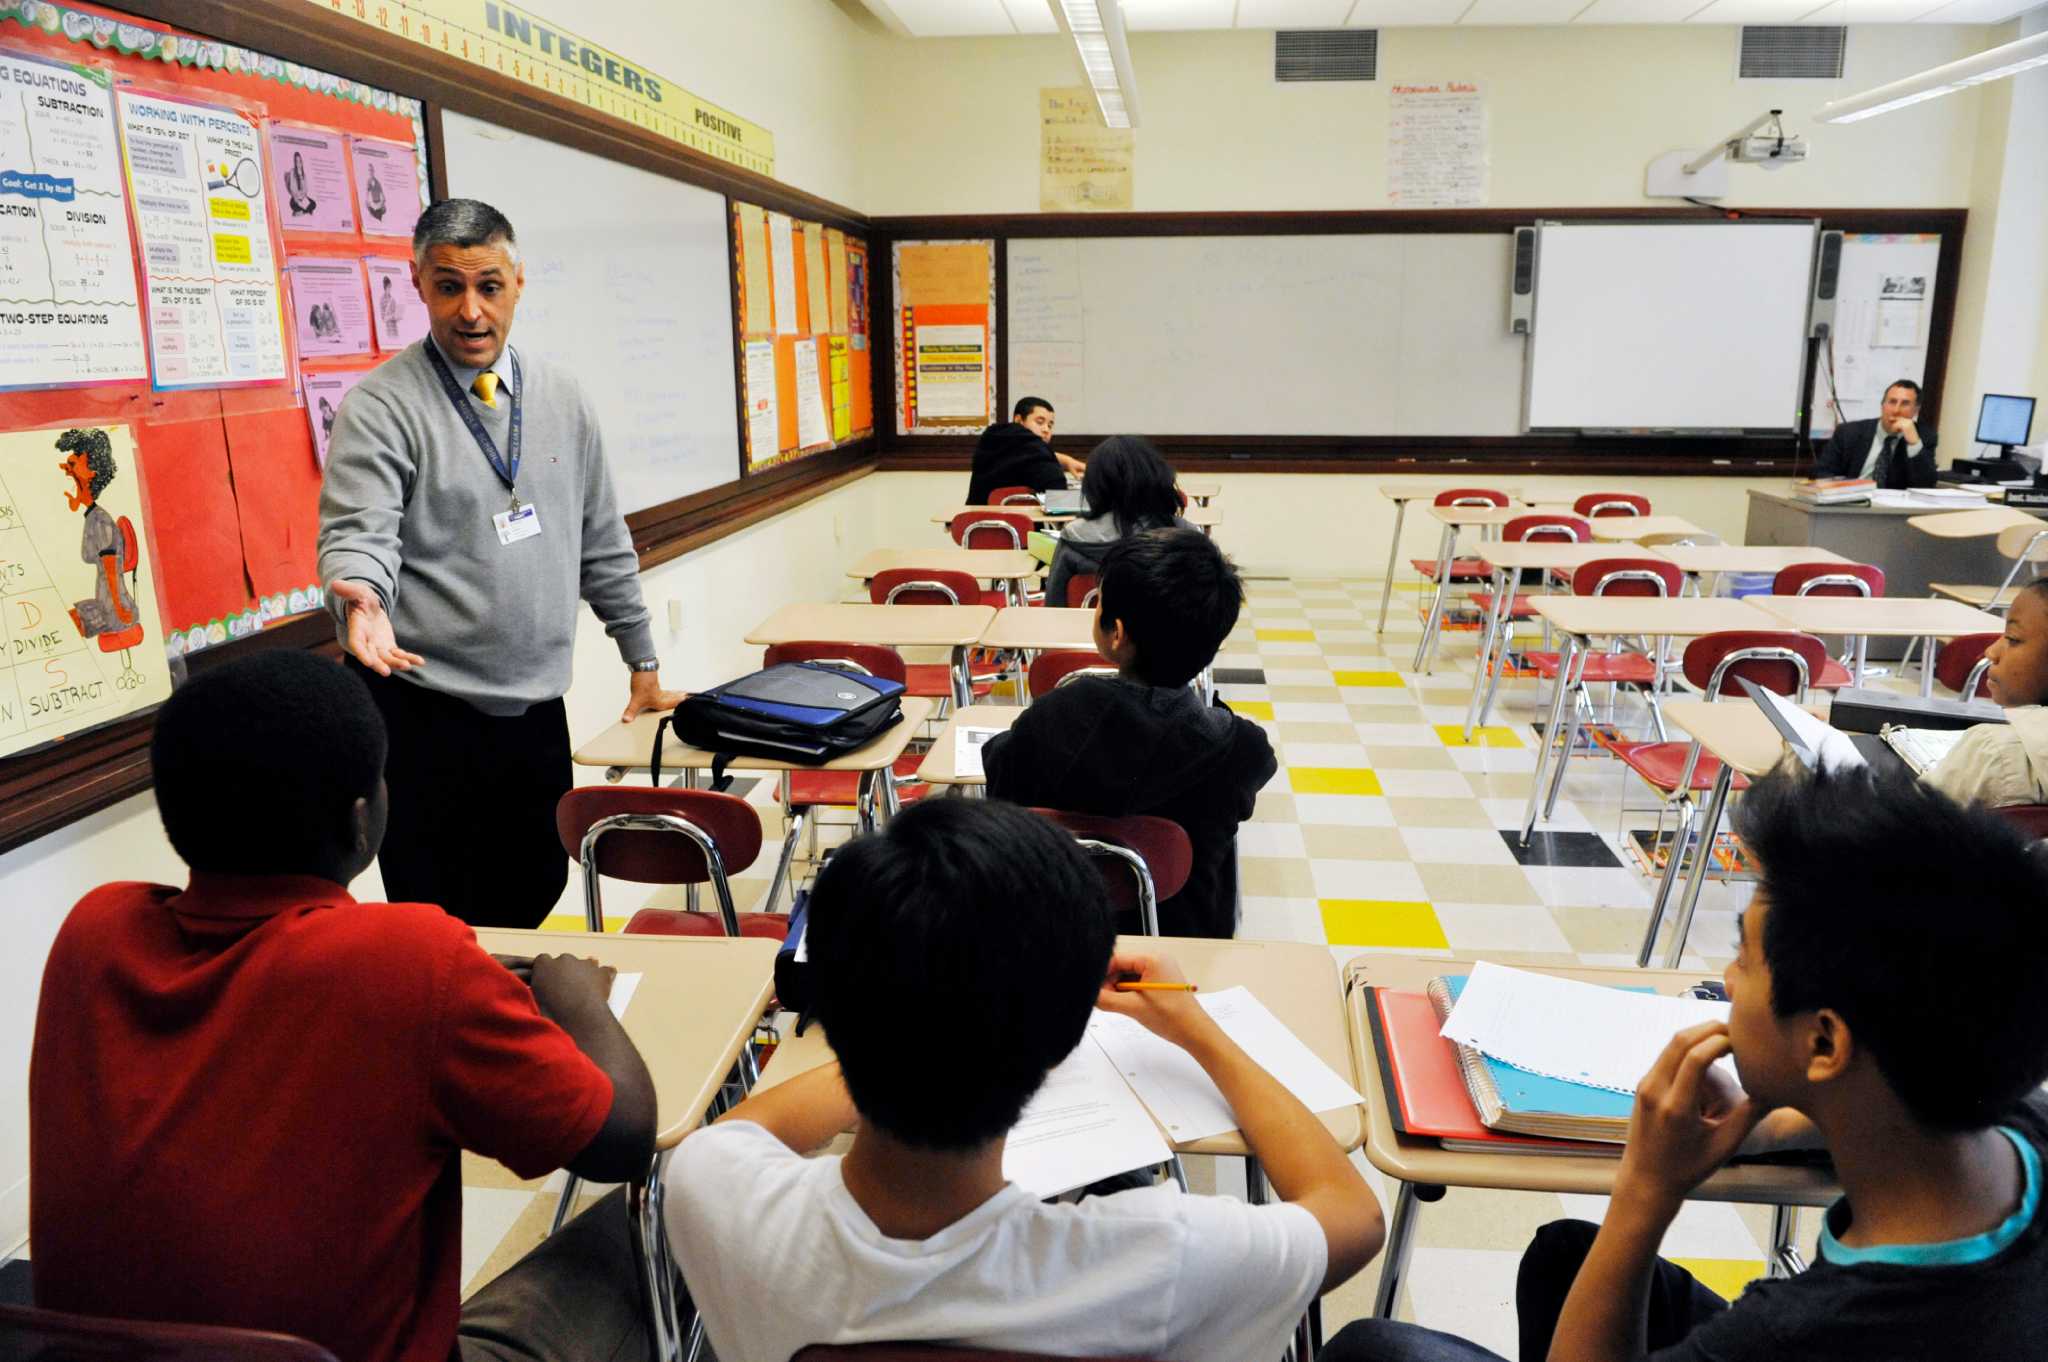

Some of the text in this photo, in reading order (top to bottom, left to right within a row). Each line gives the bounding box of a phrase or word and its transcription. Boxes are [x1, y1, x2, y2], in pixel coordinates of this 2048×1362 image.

[485, 1, 662, 102] INTEGERS
[13, 68, 87, 97] EQUATIONS
[37, 96, 104, 118] SUBTRACTION
[128, 103, 250, 136] WORKING WITH PERCENTS
[695, 108, 742, 143] POSITIVE
[66, 211, 107, 225] DIVISION
[0, 313, 108, 325] TWO-STEP EQUATIONS
[13, 630, 62, 655] DIVIDE
[30, 681, 103, 716] SUBTRACT
